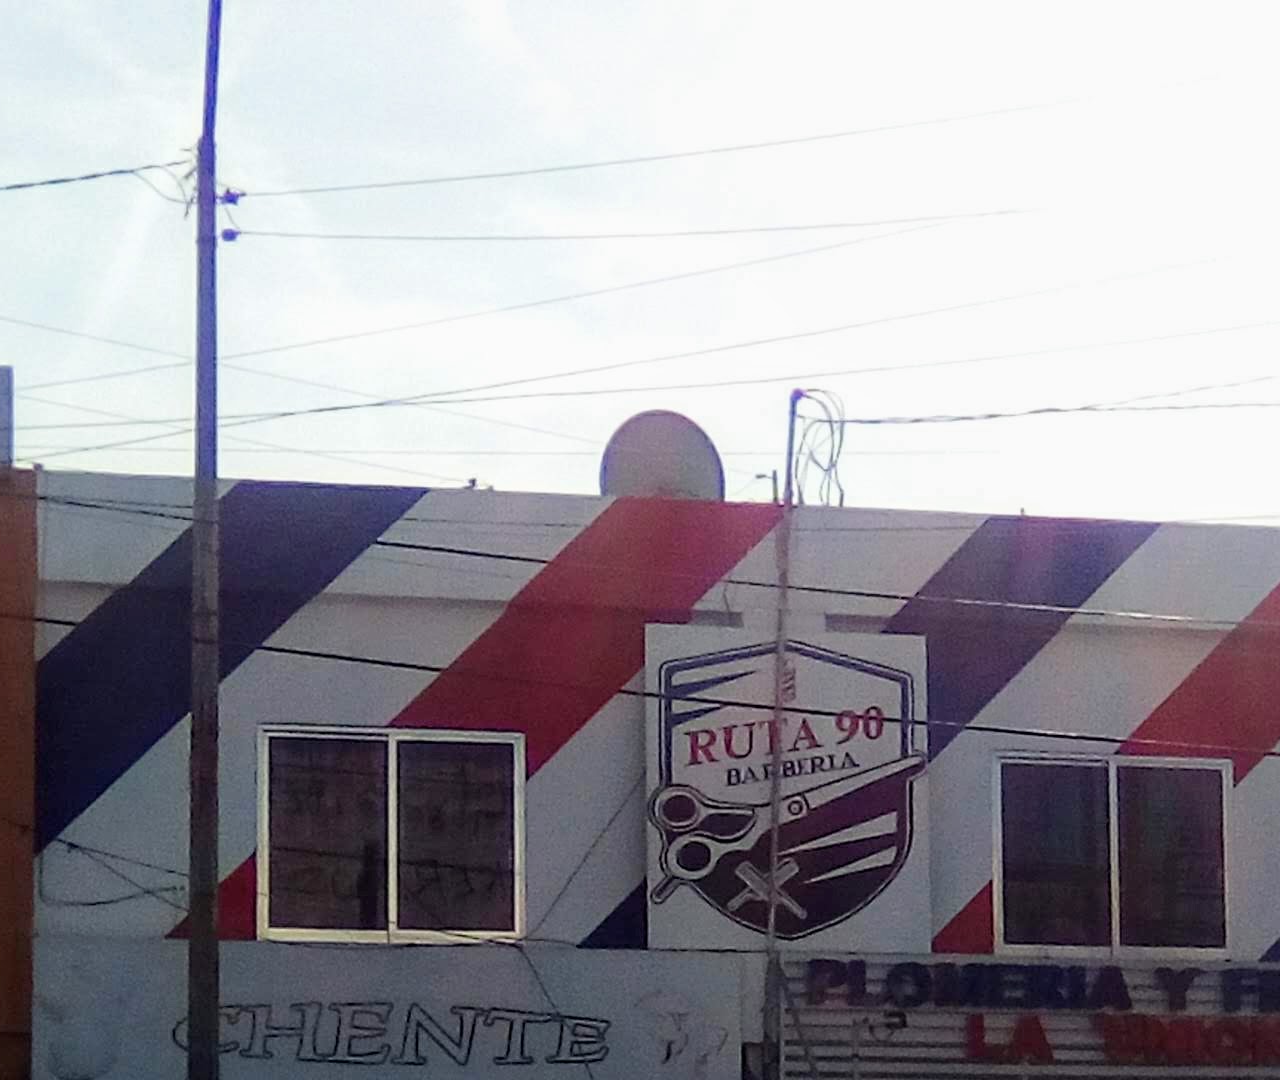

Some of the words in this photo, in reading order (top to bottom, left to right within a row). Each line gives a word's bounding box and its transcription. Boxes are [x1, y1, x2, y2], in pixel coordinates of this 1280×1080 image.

[684, 717, 824, 766] RUTA
[835, 706, 885, 746] 90
[806, 959, 1133, 1009] PLOMERIA
[1153, 966, 1201, 1010] Y
[173, 1001, 610, 1066] CHENTE
[965, 1014, 1056, 1064] LA
